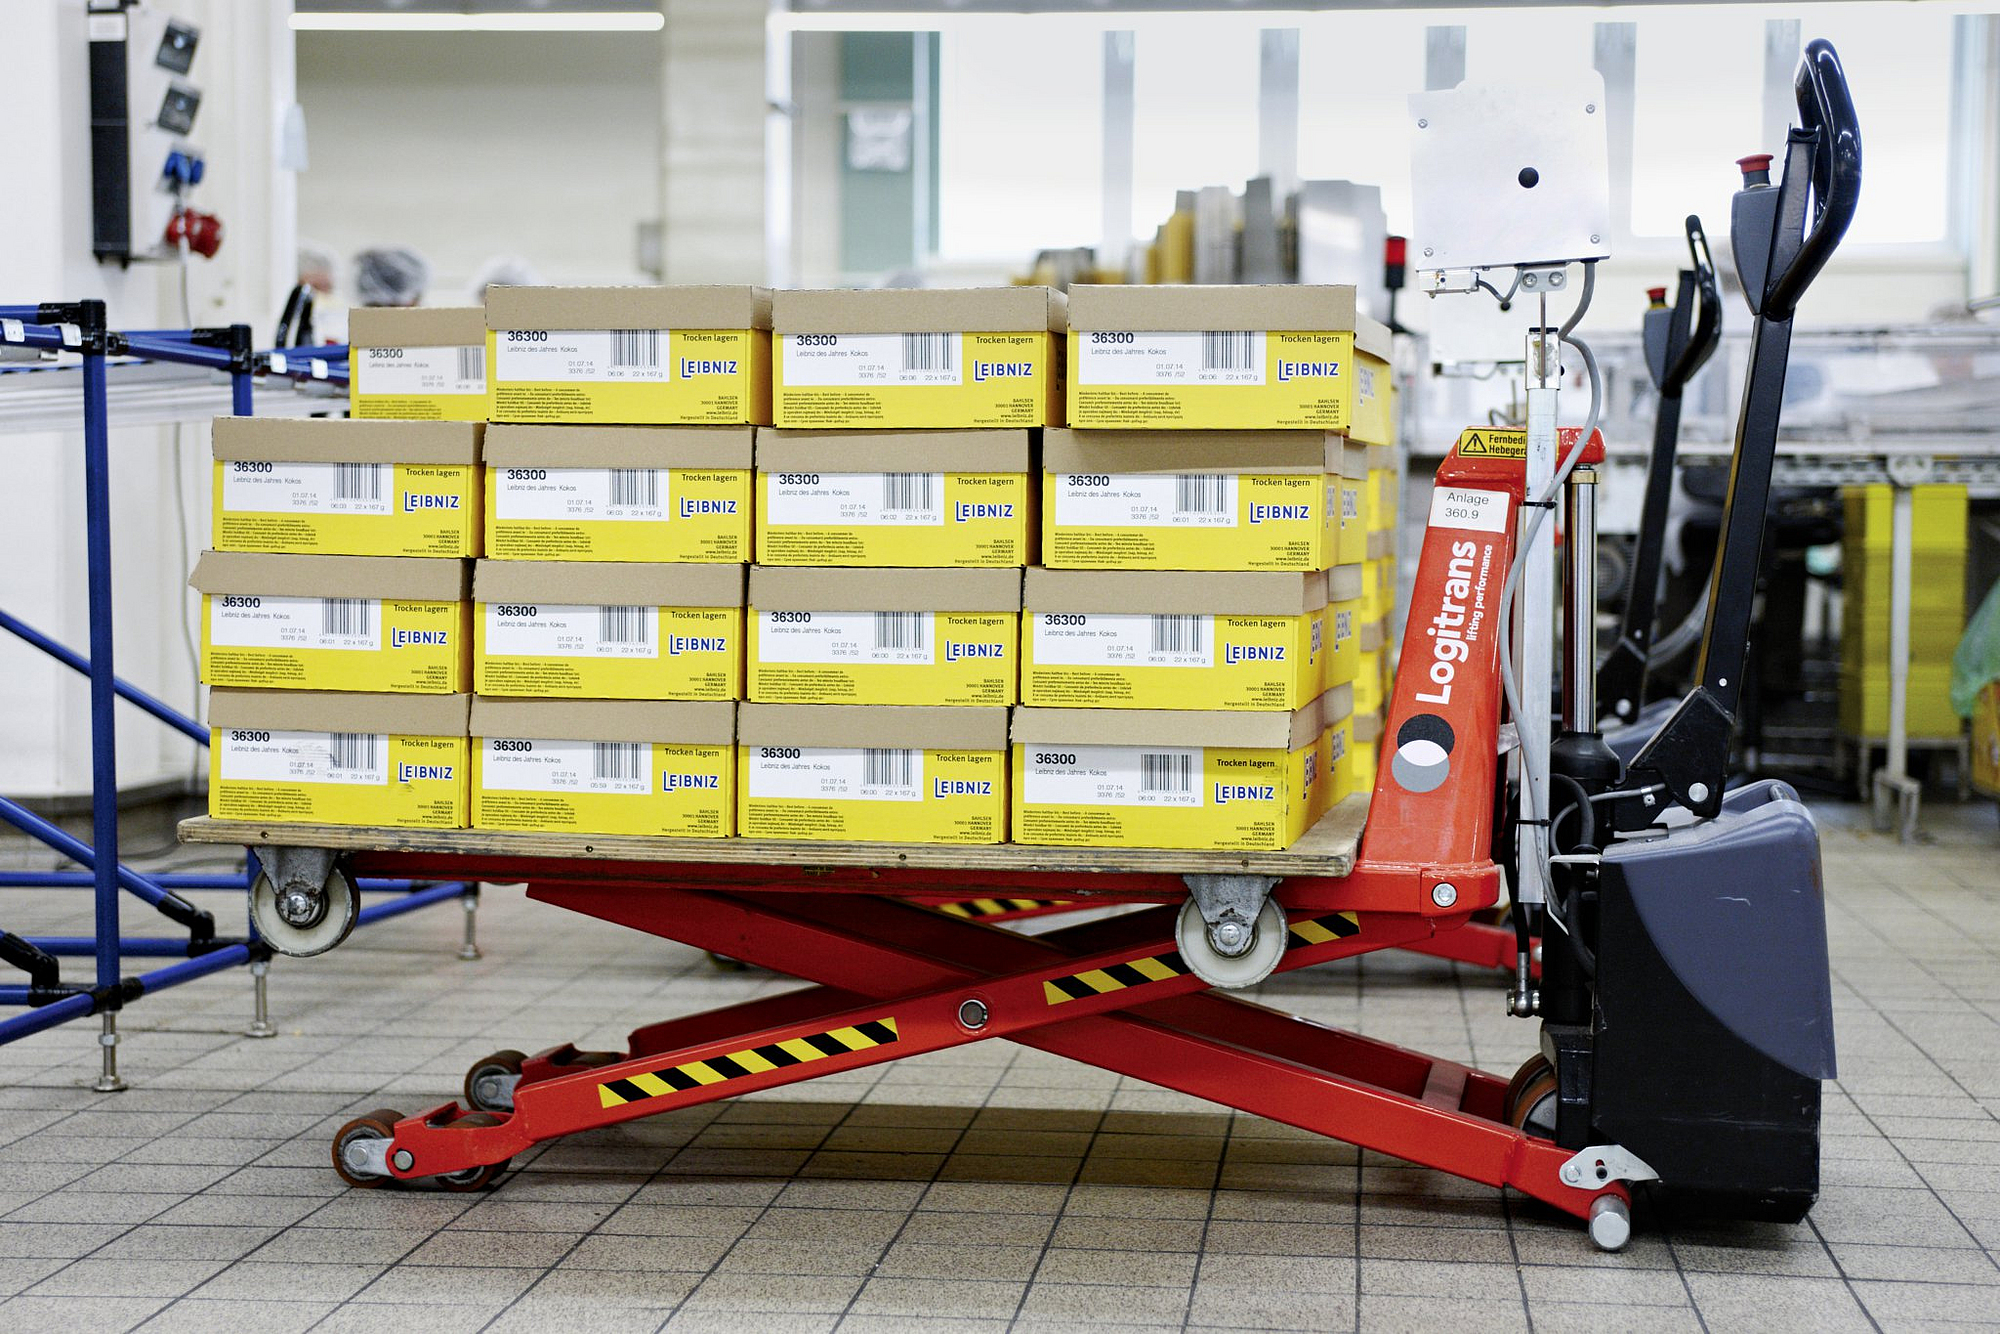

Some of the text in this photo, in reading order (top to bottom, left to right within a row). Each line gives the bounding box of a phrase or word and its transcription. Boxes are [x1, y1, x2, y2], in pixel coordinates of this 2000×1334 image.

[508, 331, 547, 341] 36300
[714, 334, 738, 343] lagern
[796, 335, 837, 345] 36300
[1008, 336, 1033, 345] lagern
[1091, 332, 1134, 343] 36300
[1314, 335, 1340, 344] lagern
[369, 349, 403, 358] 36300
[796, 349, 815, 357] Leibniz
[1091, 347, 1111, 355] Leibniz
[1112, 347, 1123, 355] des
[682, 357, 737, 377] LEIBNIZ
[975, 360, 1032, 380] LEIBNIZ
[1279, 359, 1338, 380] LEIBNIZ
[233, 461, 272, 473] 36300
[406, 468, 460, 478] Trocken lagern
[507, 469, 546, 480] 36300
[234, 475, 252, 483] Leibniz
[713, 474, 737, 483] lagern
[779, 474, 819, 485] 36300
[957, 477, 1014, 486] Trocken lagern
[1068, 475, 1109, 486] 36300
[1252, 478, 1310, 487] Trocken lagern
[507, 483, 526, 491] Leibniz
[779, 488, 798, 496] Leibniz
[798, 488, 809, 496] des
[1068, 489, 1087, 498] Leibniz
[1088, 490, 1099, 498] des
[1100, 490, 1120, 498] Jahres
[405, 491, 459, 512] LEIBNIZ
[1447, 492, 1489, 506] Anlage
[681, 497, 736, 517] LEIBNIZ
[956, 501, 1013, 521] LEIBNIZ
[1250, 502, 1309, 523] LEIBNIZ
[1445, 507, 1479, 519] 360.9
[1466, 544, 1493, 641] lifting performance
[221, 596, 260, 608] 36300
[394, 604, 448, 614] Trocken lagern
[497, 605, 537, 617] 36300
[221, 610, 240, 618] Leibniz
[240, 611, 250, 619] des
[671, 611, 726, 620] Trocken lagern
[771, 611, 811, 623] 36300
[1044, 614, 1086, 625] 36300
[497, 619, 516, 627] Leibniz
[979, 617, 1004, 626] lagern
[1227, 619, 1286, 629] Trocken lagern
[1415, 541, 1476, 705] Logitrans
[771, 625, 790, 634] Leibniz
[790, 626, 800, 634] des
[1045, 628, 1064, 637] Leibniz
[1065, 629, 1075, 637] des
[393, 627, 447, 648] LEIBNIZ
[670, 634, 725, 655] LEIBNIZ
[947, 640, 1003, 661] LEIBNIZ
[1226, 643, 1284, 664] LEIBNIZ
[231, 730, 269, 742] 36300
[231, 744, 249, 752] Leibniz
[401, 739, 454, 749] Trocken lagern
[493, 740, 532, 752] 36300
[493, 754, 511, 762] Leibniz
[665, 748, 719, 758] Trocken lagern
[761, 747, 800, 759] 36300
[936, 754, 992, 764] Trocken lagern
[1035, 753, 1076, 765] 36300
[1217, 759, 1275, 769] Trocken lagern
[761, 761, 779, 769] Leibniz
[400, 762, 453, 783] LEIBNIZ
[1035, 767, 1054, 775] Leibniz
[1067, 768, 1086, 776] Jahres
[664, 771, 718, 792] LEIBNIZ
[935, 777, 991, 798] LEIBNIZ
[1216, 782, 1274, 803] LEIBNIZ
